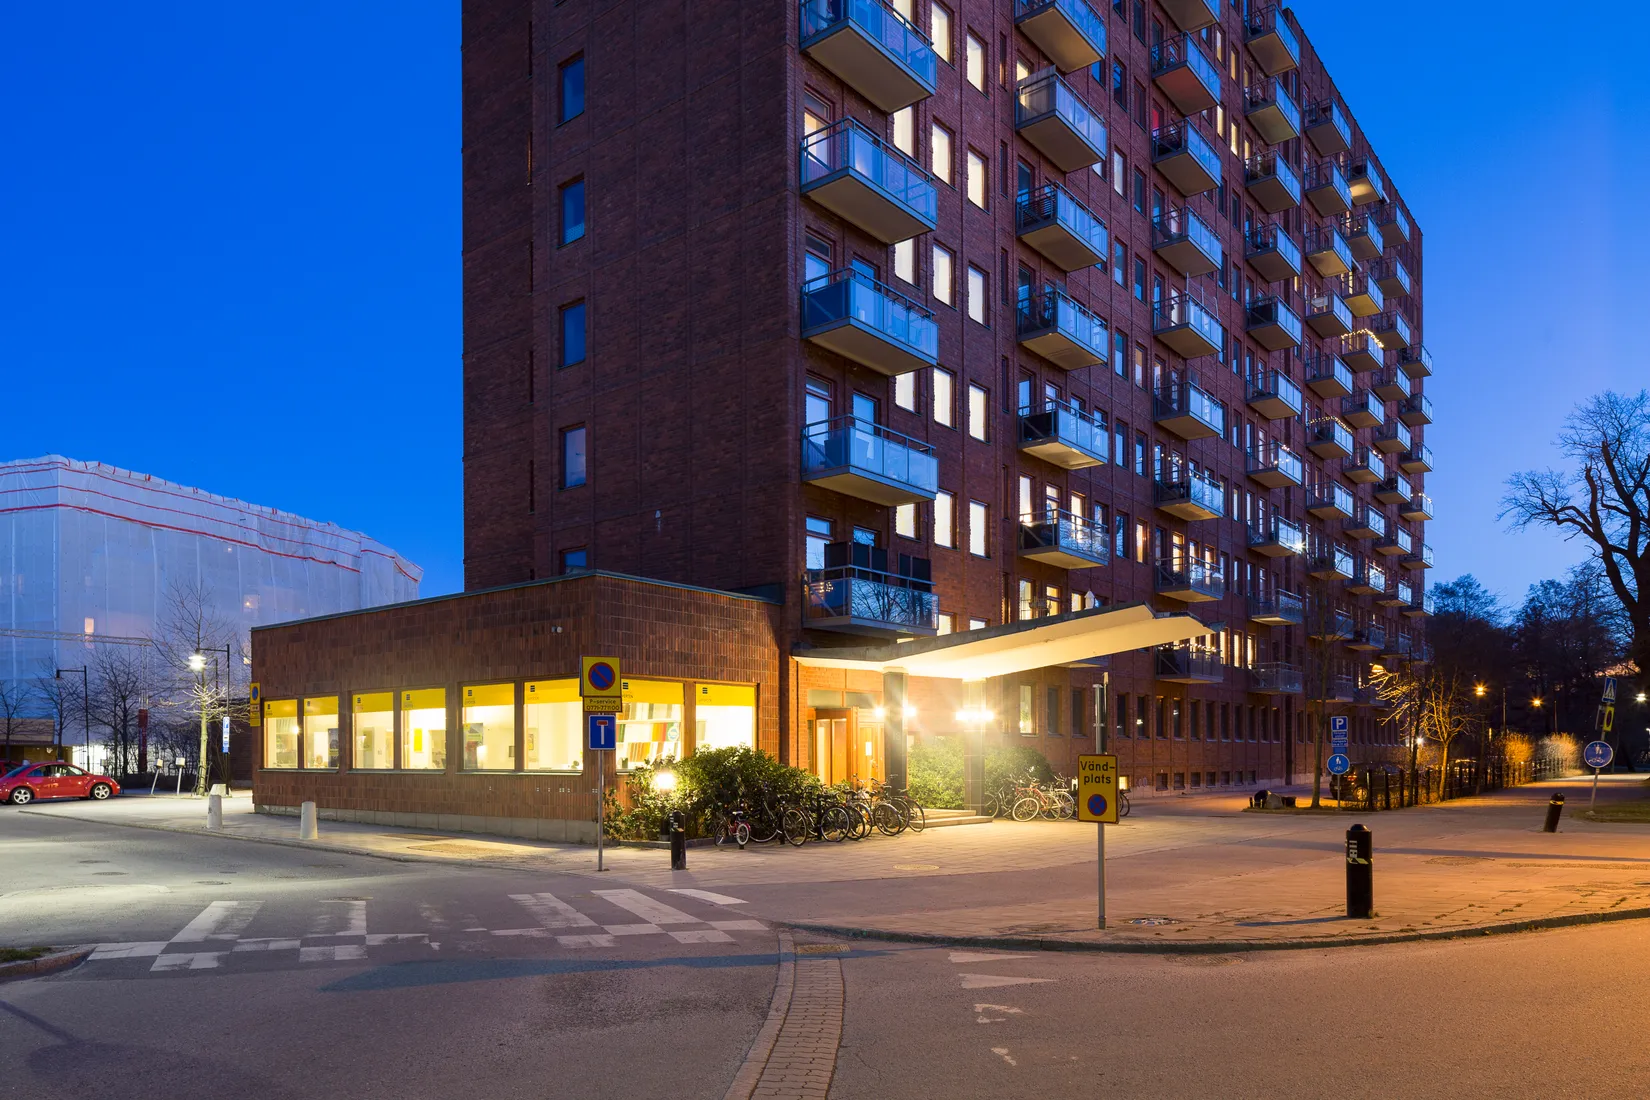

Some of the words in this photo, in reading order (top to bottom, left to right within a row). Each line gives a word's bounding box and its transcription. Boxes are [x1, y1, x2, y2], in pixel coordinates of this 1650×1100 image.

[1336, 718, 1344, 729] P
[1080, 760, 1116, 772] Vänd-
[1084, 773, 1112, 785] plats
